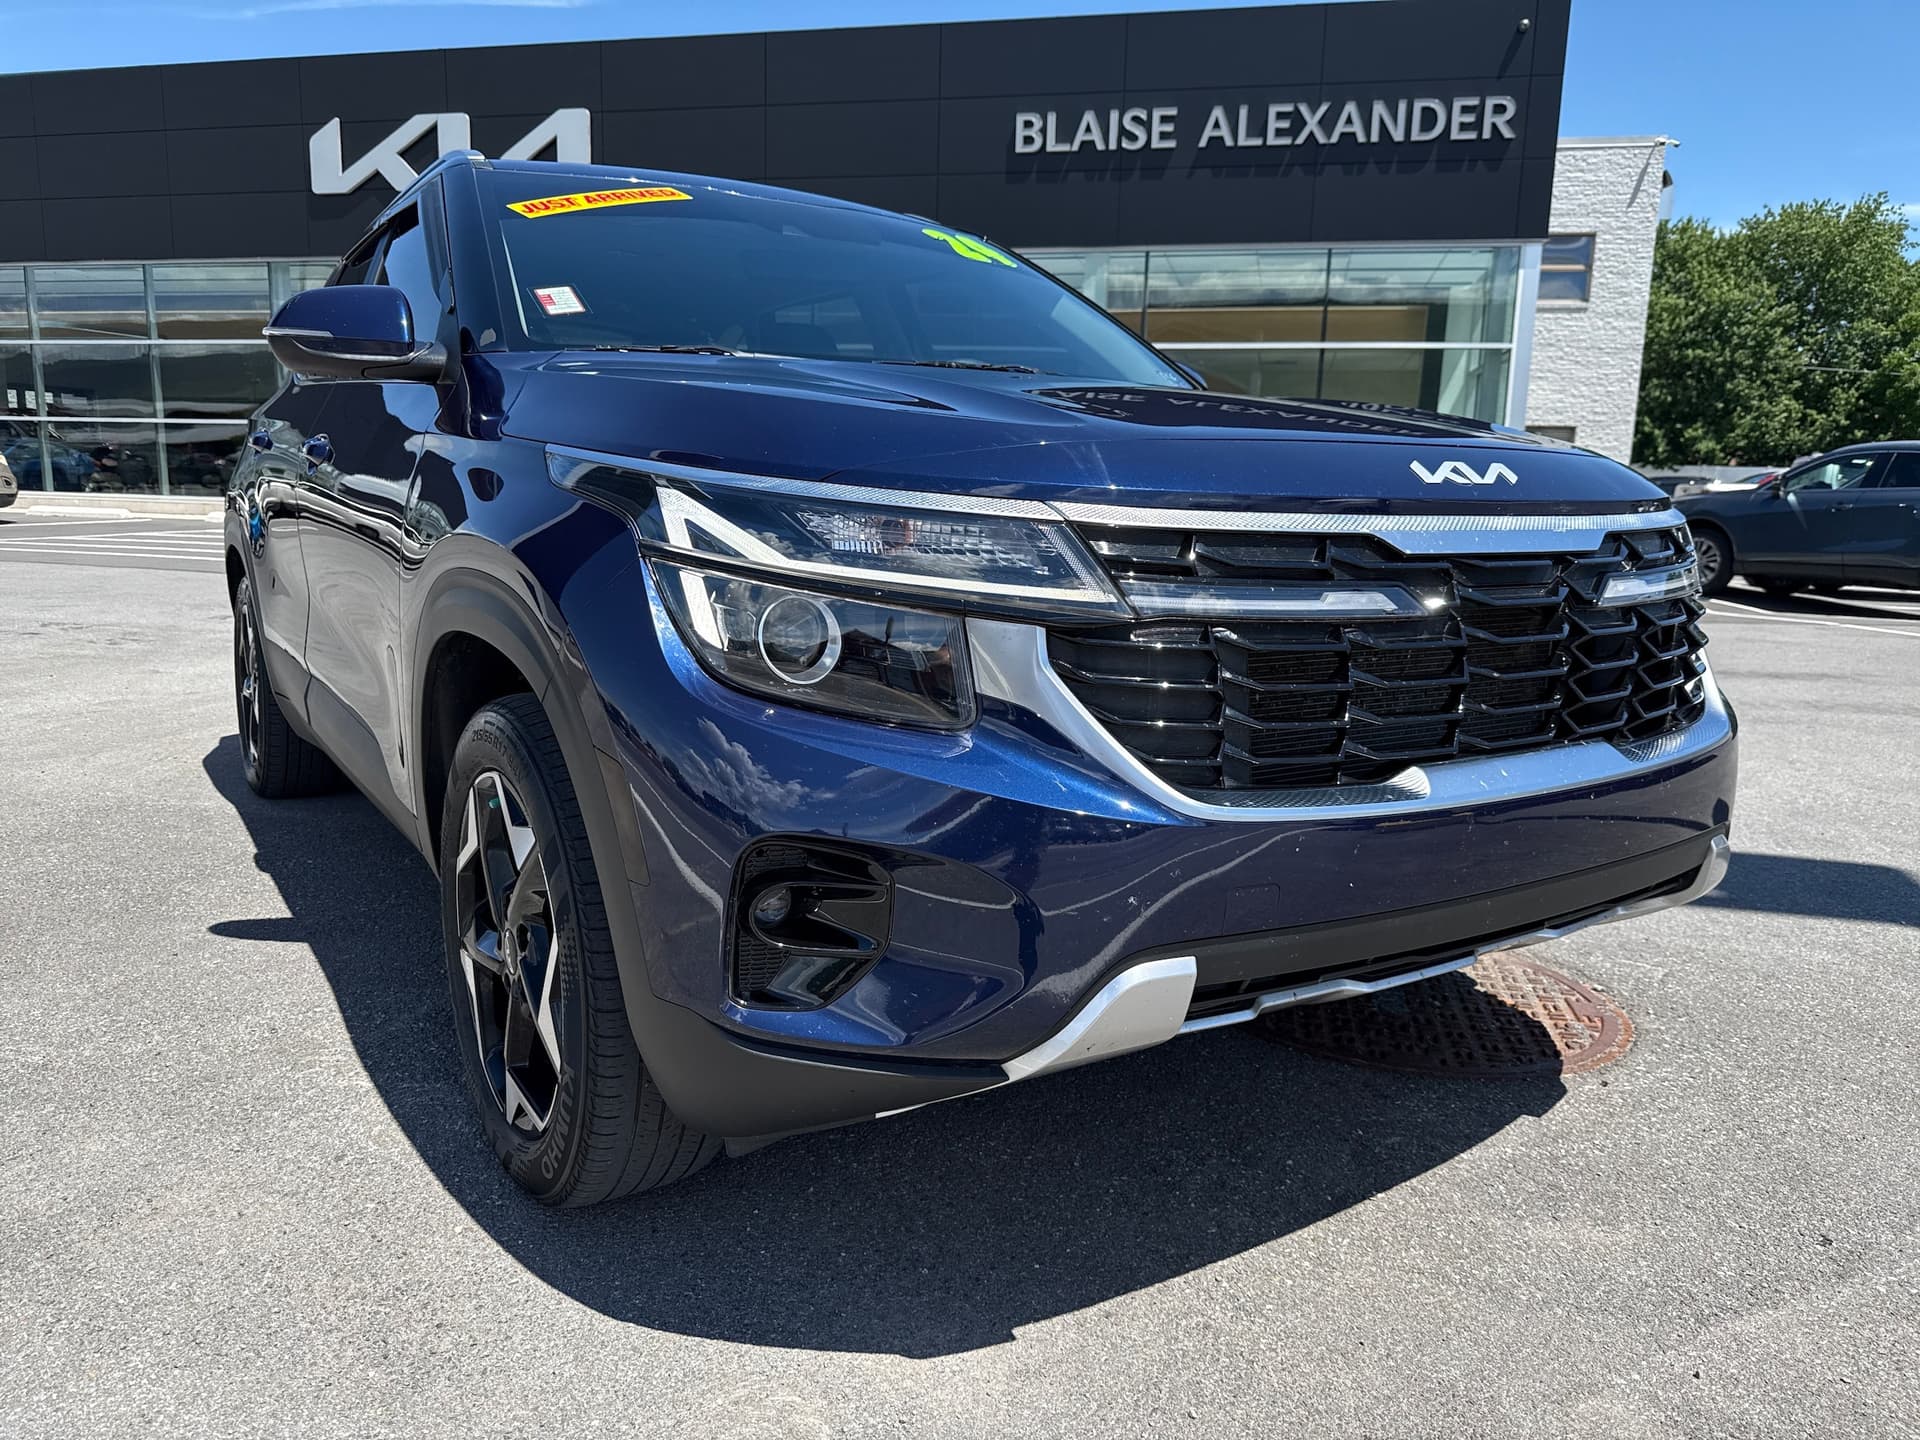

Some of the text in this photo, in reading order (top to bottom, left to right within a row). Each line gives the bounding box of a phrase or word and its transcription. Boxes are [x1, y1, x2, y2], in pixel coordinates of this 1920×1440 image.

[1014, 95, 1517, 154] BLAISE ALEXANDER
[521, 188, 682, 215] JUST ARRIVED
[1409, 459, 1518, 487] KIA
[541, 1061, 575, 1180] KUMHO
